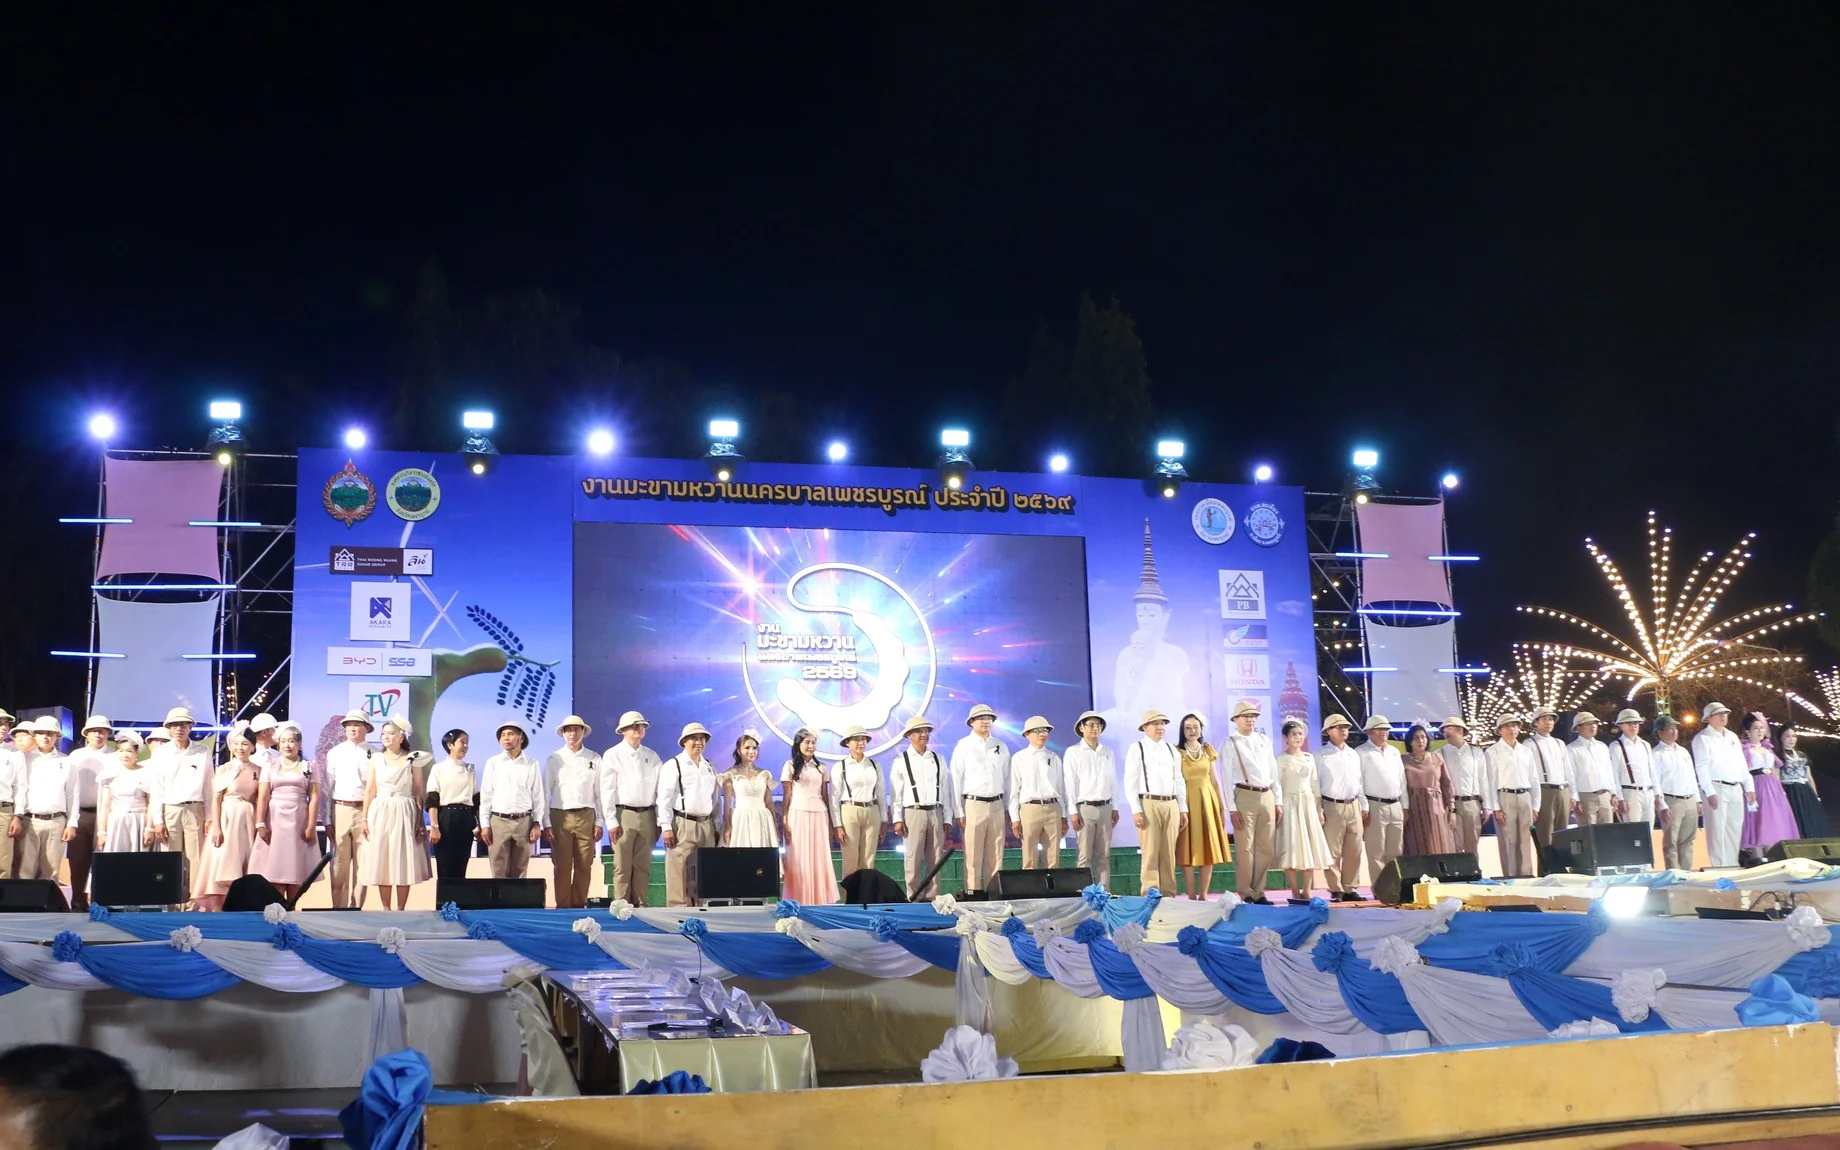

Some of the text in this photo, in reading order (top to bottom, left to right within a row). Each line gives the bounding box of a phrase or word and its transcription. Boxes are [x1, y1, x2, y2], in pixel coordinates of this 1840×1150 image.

[582, 477, 1072, 511] งานมะขามหวานนครบาลเพชรบูรณ์ ประจำปี ๒๕๖๙
[1236, 600, 1250, 610] PB
[757, 623, 781, 633] งาน
[757, 634, 856, 650] มะขามหวาน
[343, 656, 416, 667] BYD SSB
[802, 665, 858, 680] 2569
[365, 694, 393, 717] TV
